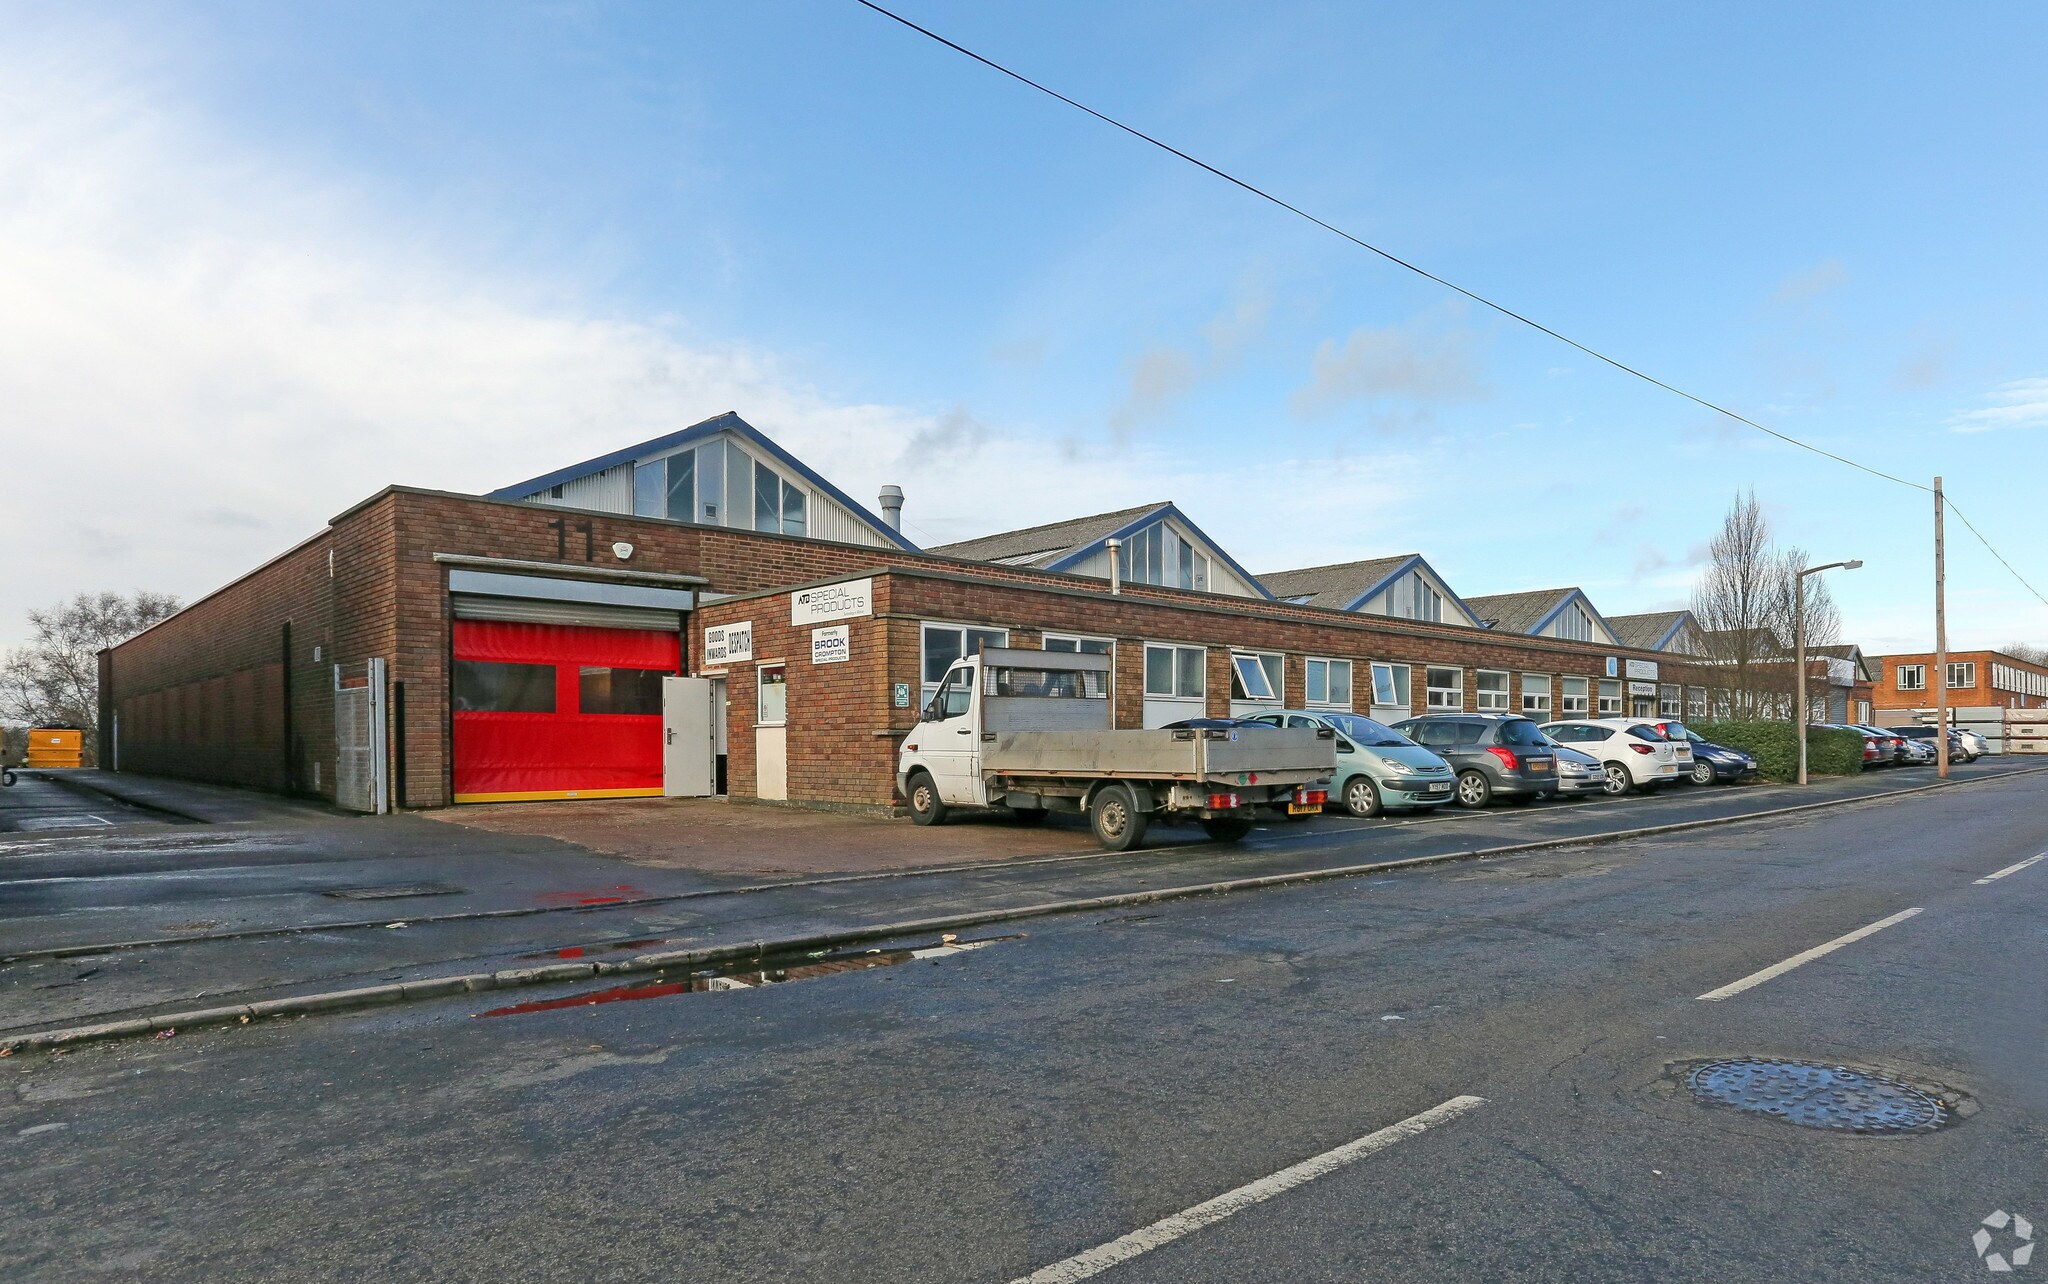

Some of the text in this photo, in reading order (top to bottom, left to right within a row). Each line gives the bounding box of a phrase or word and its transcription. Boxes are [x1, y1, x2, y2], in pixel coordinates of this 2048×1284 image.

[548, 517, 593, 562] 11
[811, 587, 850, 603] SPECIAL
[811, 596, 864, 615] PRODUCTS
[708, 630, 725, 643] GOODS
[728, 629, 751, 655] DESPATCH
[814, 637, 846, 650] BROOK
[706, 646, 727, 660] INWARDS
[814, 649, 847, 658] CROMPTON
[1632, 683, 1653, 693] Reception
